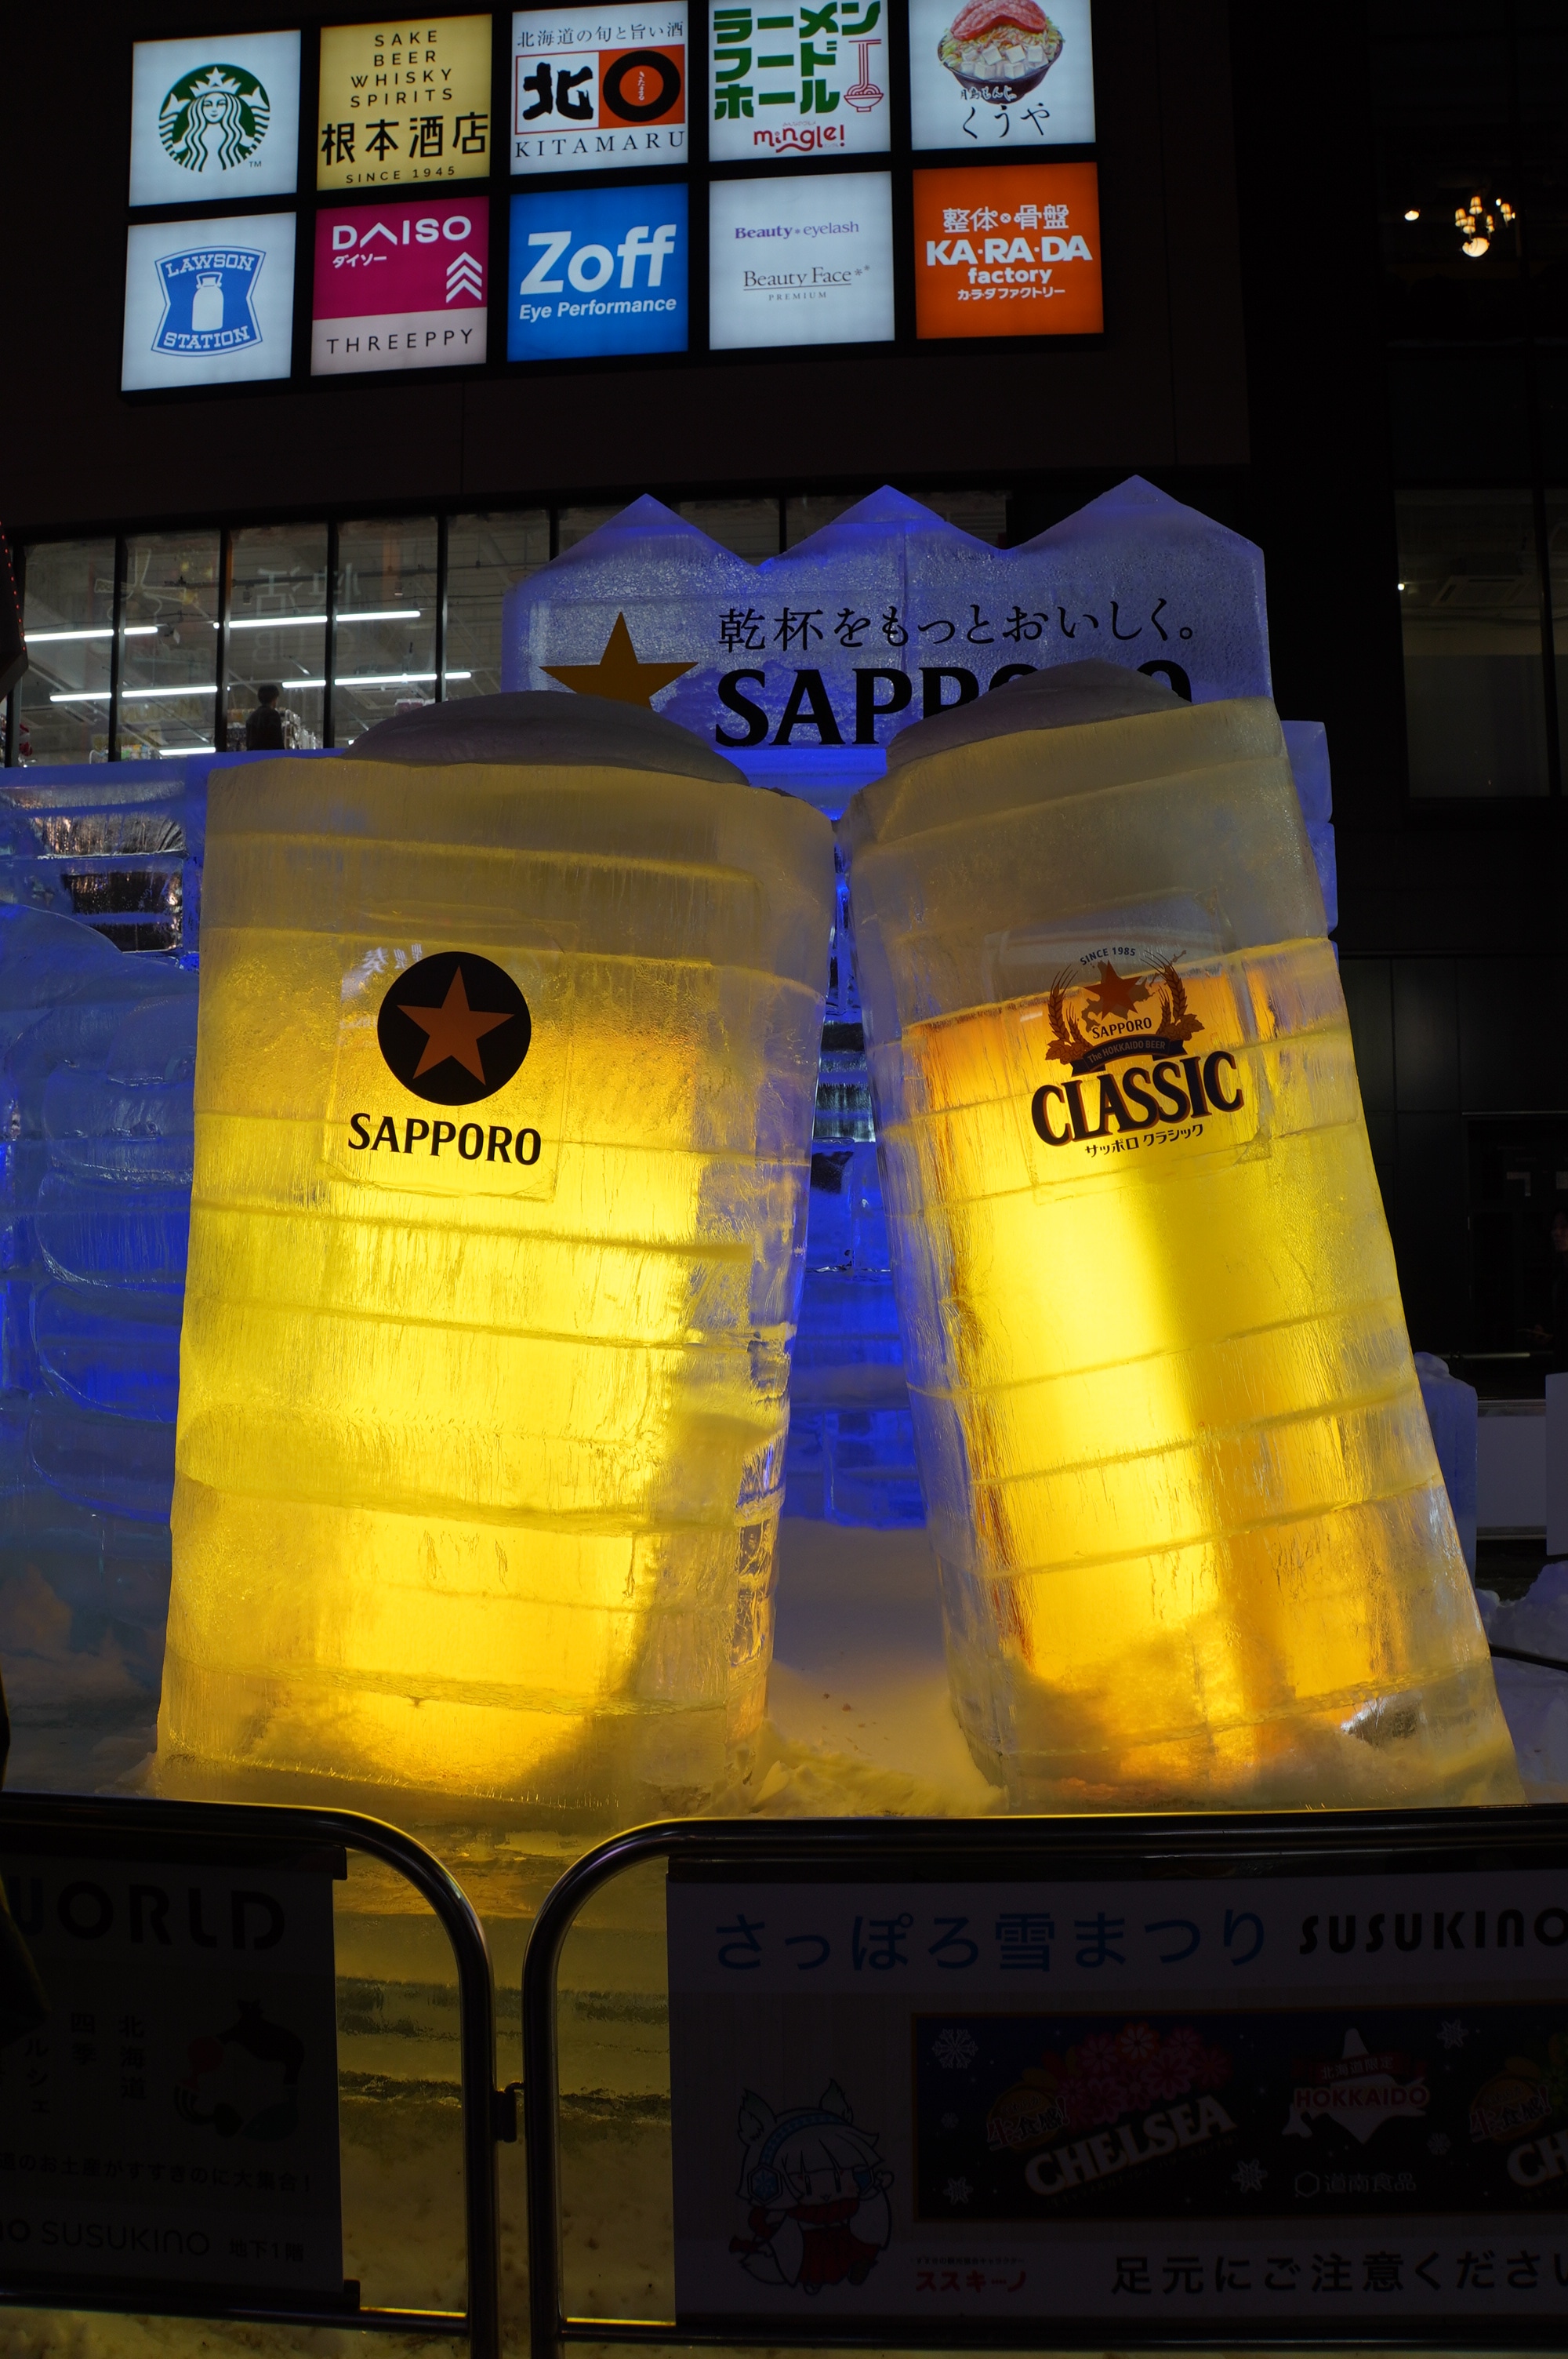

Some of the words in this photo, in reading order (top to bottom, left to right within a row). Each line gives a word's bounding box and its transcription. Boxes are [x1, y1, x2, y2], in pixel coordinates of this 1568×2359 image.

[517, 20, 684, 48] 北海道の旬と旨い酒
[713, 1, 880, 44] ラーメン
[375, 30, 437, 47] SAKE
[373, 50, 436, 67] BEER
[713, 42, 838, 82] フード
[350, 67, 452, 88] WHISKY
[350, 88, 453, 107] SPIRITS
[714, 79, 840, 120] ホール
[962, 103, 1050, 139] くうや
[321, 111, 488, 165] 根本酒店
[515, 131, 685, 158] KITAMARU
[754, 124, 845, 153] mingle!
[346, 170, 401, 184] SINCE
[412, 166, 456, 180] 1945
[332, 215, 472, 250] DAISO
[735, 225, 793, 241] Beauty
[803, 221, 859, 238] eyelash
[165, 253, 255, 278] LAWSON
[332, 253, 387, 268] ダイソー
[519, 224, 677, 295] Zoff
[743, 270, 807, 288] Beauty
[811, 267, 851, 284] Face
[968, 267, 1052, 285] factory
[519, 304, 552, 322] Eye
[557, 296, 677, 318] Performance
[768, 291, 827, 301] PREMIUM
[163, 325, 250, 349] STATION
[327, 329, 473, 354] THREEPPY
[717, 597, 1195, 653] 乾杯をもっとおいしく。
[715, 660, 1192, 747] SAPP
[1080, 947, 1109, 965] SINCE
[1112, 947, 1136, 956] 1985
[1092, 1017, 1152, 1039] SAPPORO
[1087, 1052, 1103, 1063] The
[1102, 1041, 1144, 1056] HOKKAIDO
[1145, 1040, 1166, 1049] BEER
[1031, 1050, 1244, 1147] CLASSIC
[348, 1113, 541, 1165] SAPPORO
[1085, 1137, 1139, 1158] サッポロ
[1143, 1124, 1203, 1147] クラシック
[716, 1909, 1265, 1972] さっぽろ雪まつり
[1300, 1907, 1568, 1954] SUSUKINO
[118, 2015, 147, 2102] 北海道
[1296, 2087, 1427, 2108] HOKKAIDO
[1025, 2094, 1239, 2196] CHELSEA
[1324, 2172, 1417, 2194] 道南食品
[42, 2220, 210, 2256] SUSUKINO
